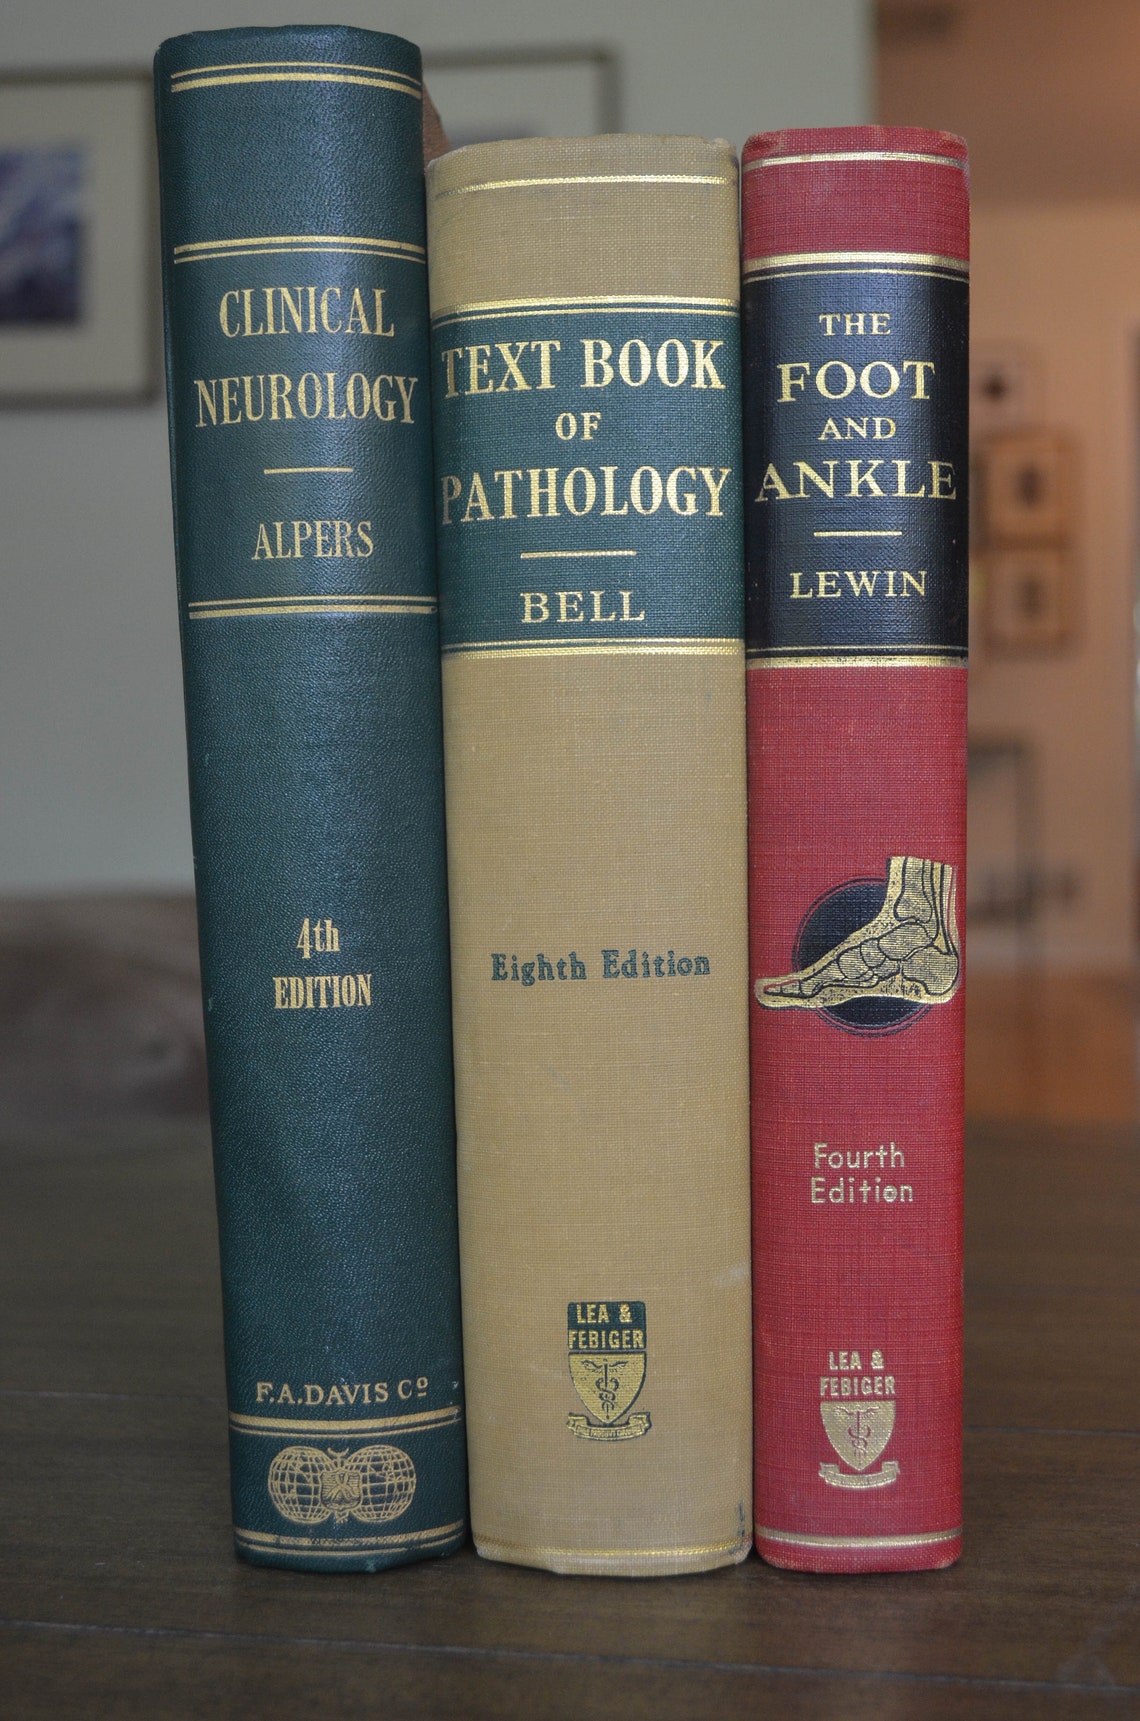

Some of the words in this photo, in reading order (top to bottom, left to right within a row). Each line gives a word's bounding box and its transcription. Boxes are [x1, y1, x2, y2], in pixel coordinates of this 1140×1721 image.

[219, 287, 395, 338] CLINICAL
[818, 313, 891, 336] THE
[441, 340, 561, 398] TEXT
[580, 338, 726, 389] BOOK
[776, 360, 936, 403] FOOT
[194, 372, 418, 428] NEUROLOGY
[555, 412, 601, 440] OF
[818, 417, 897, 440] AND
[440, 466, 732, 525] PATHOLOGY
[754, 459, 957, 502] ANKLE
[252, 520, 375, 560] ALPERS
[790, 571, 927, 599] LEWIN
[520, 590, 646, 623] BELL
[296, 917, 340, 959] 4th
[491, 951, 587, 986] Eighth
[601, 949, 711, 979] Edition
[272, 973, 372, 1009] EDITION
[814, 1142, 905, 1169] Fourth
[811, 1177, 913, 1203] Edition
[576, 1303, 610, 1324] LEA
[619, 1303, 633, 1323] &
[568, 1329, 645, 1349] FEBIGER
[829, 1350, 862, 1371] LEA
[870, 1349, 885, 1370] &
[820, 1376, 896, 1396] FEBIGER
